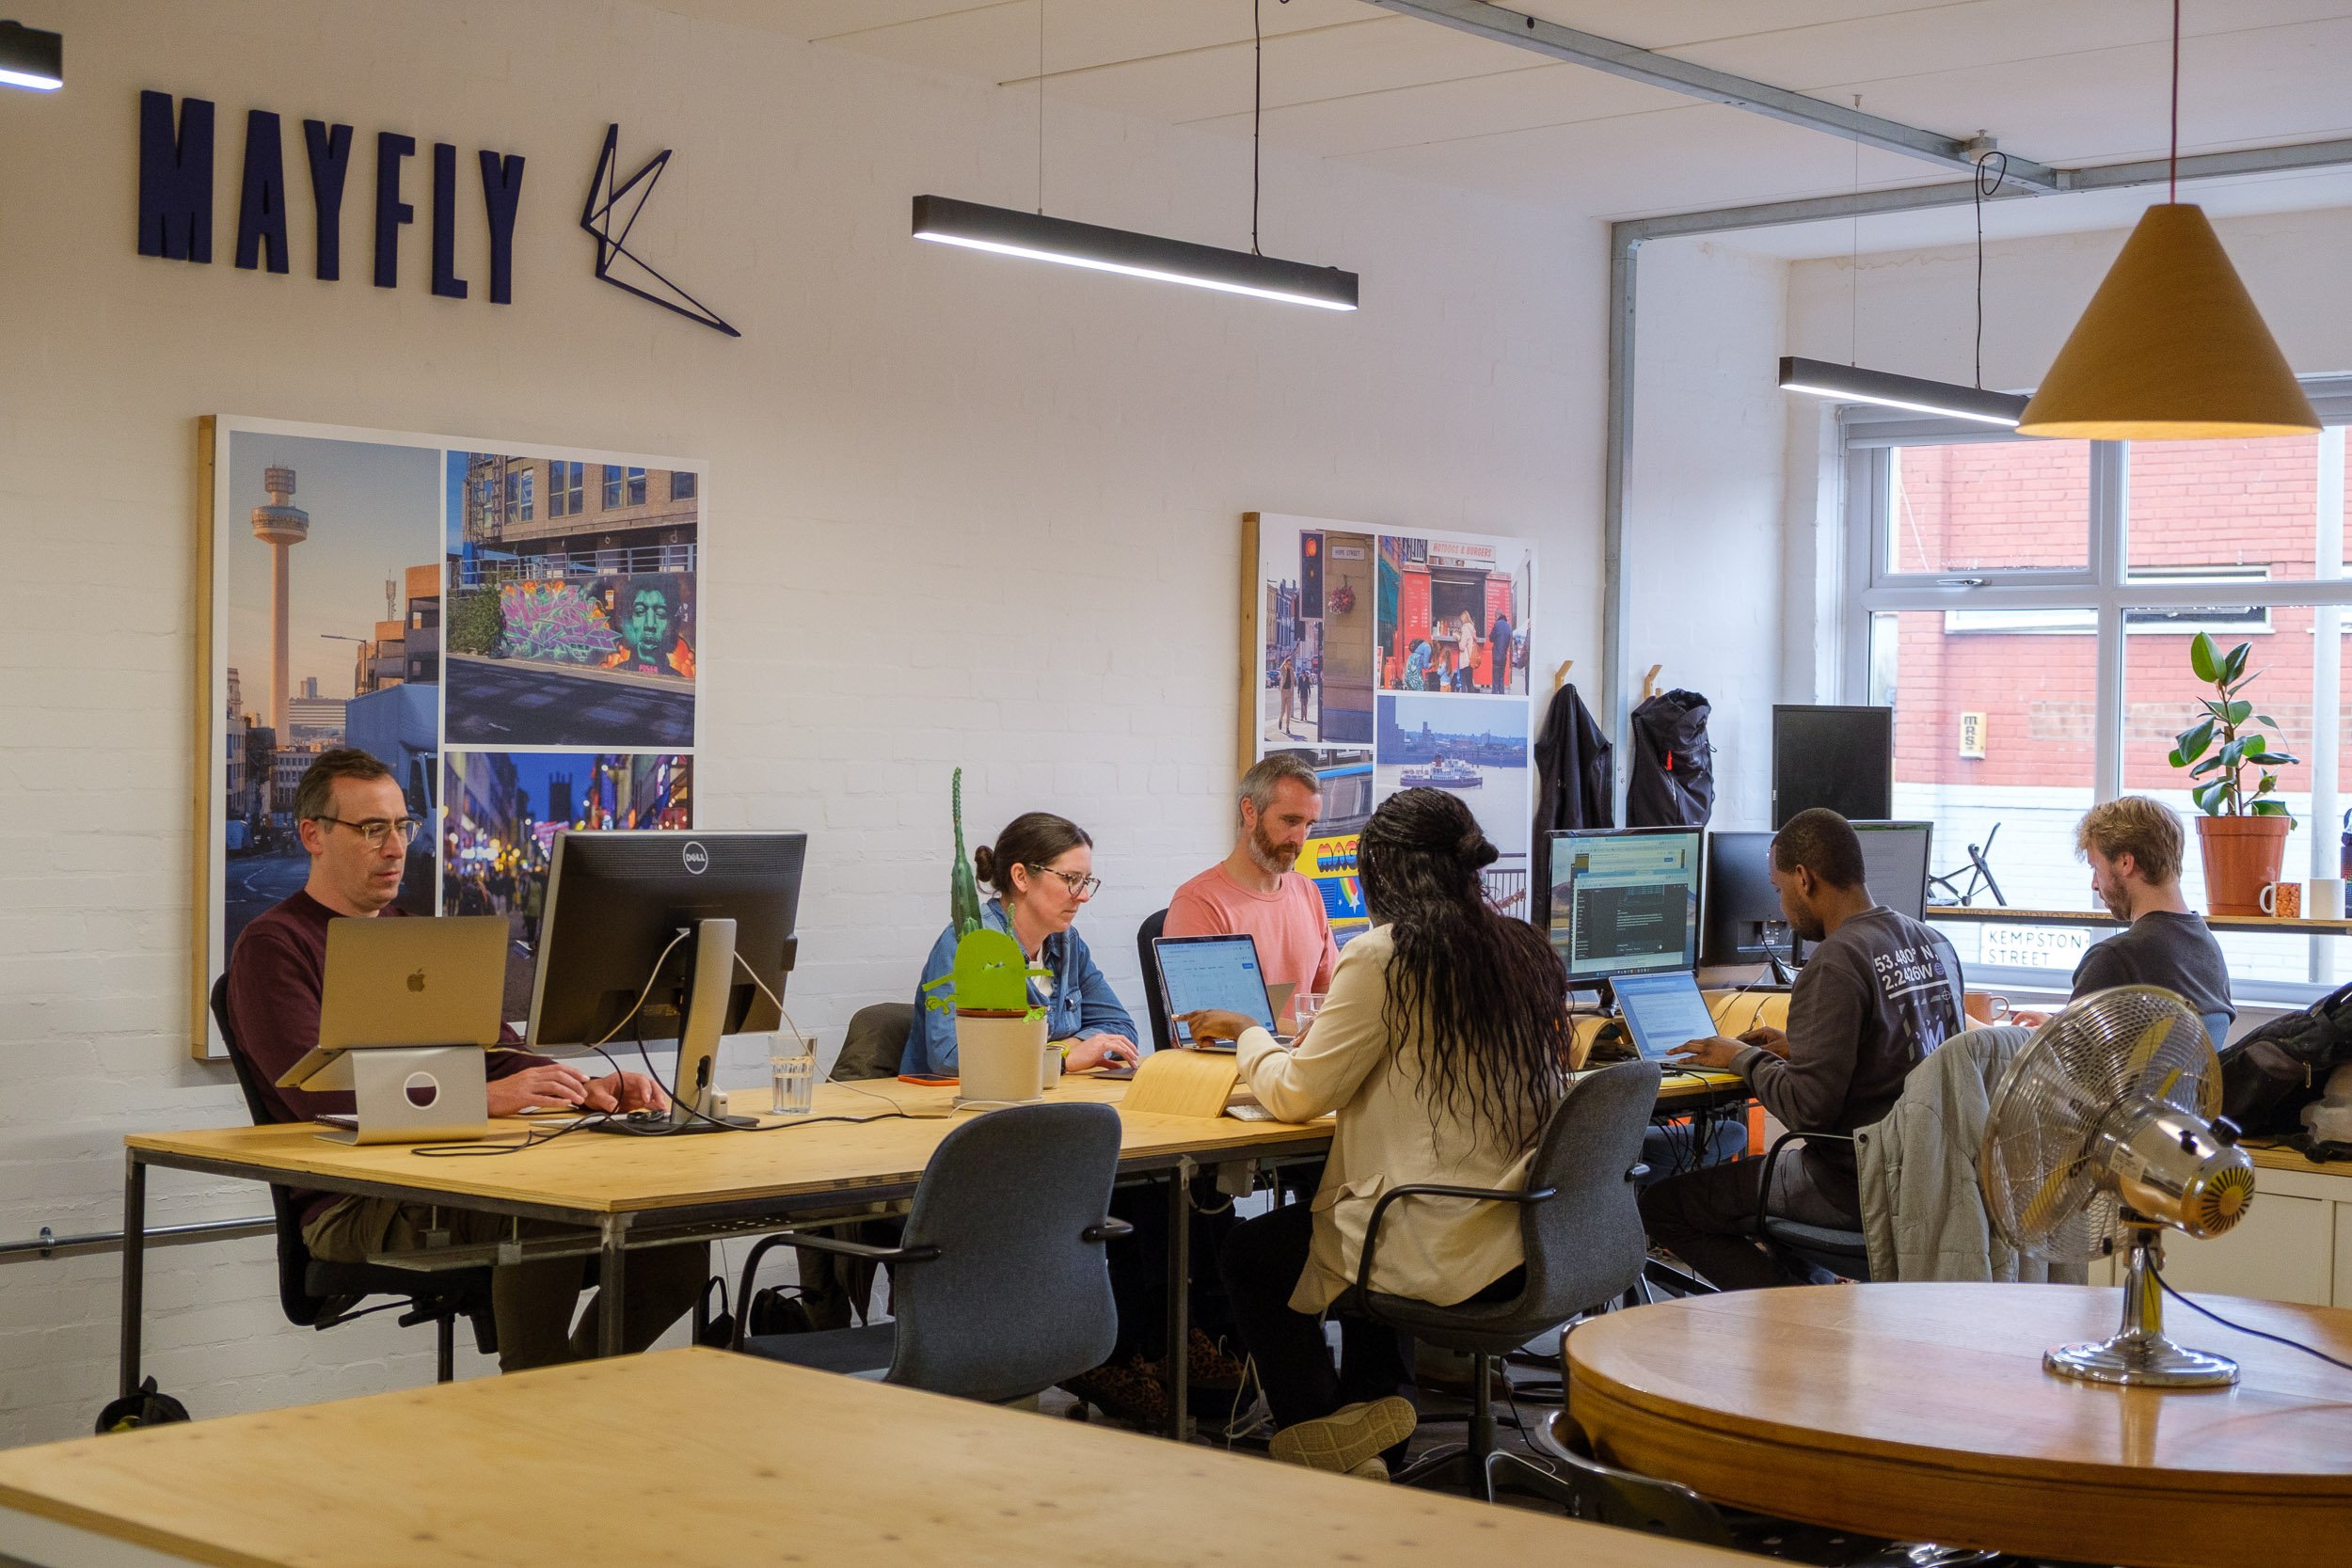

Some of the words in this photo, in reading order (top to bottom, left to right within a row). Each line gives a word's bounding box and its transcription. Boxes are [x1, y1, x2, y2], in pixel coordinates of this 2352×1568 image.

[137, 89, 526, 305] MAYFLY
[1433, 543, 1459, 554] HOTDOGS
[1466, 546, 1492, 558] BURGERS
[685, 853, 706, 863] DELL
[1316, 839, 1359, 872] MAG
[1989, 929, 2082, 949] KEMPSTON
[1873, 947, 1916, 974] 53.480°
[1920, 944, 1939, 960] N,
[1989, 948, 2049, 966] STREET
[1882, 962, 1932, 990] 2.2426W
